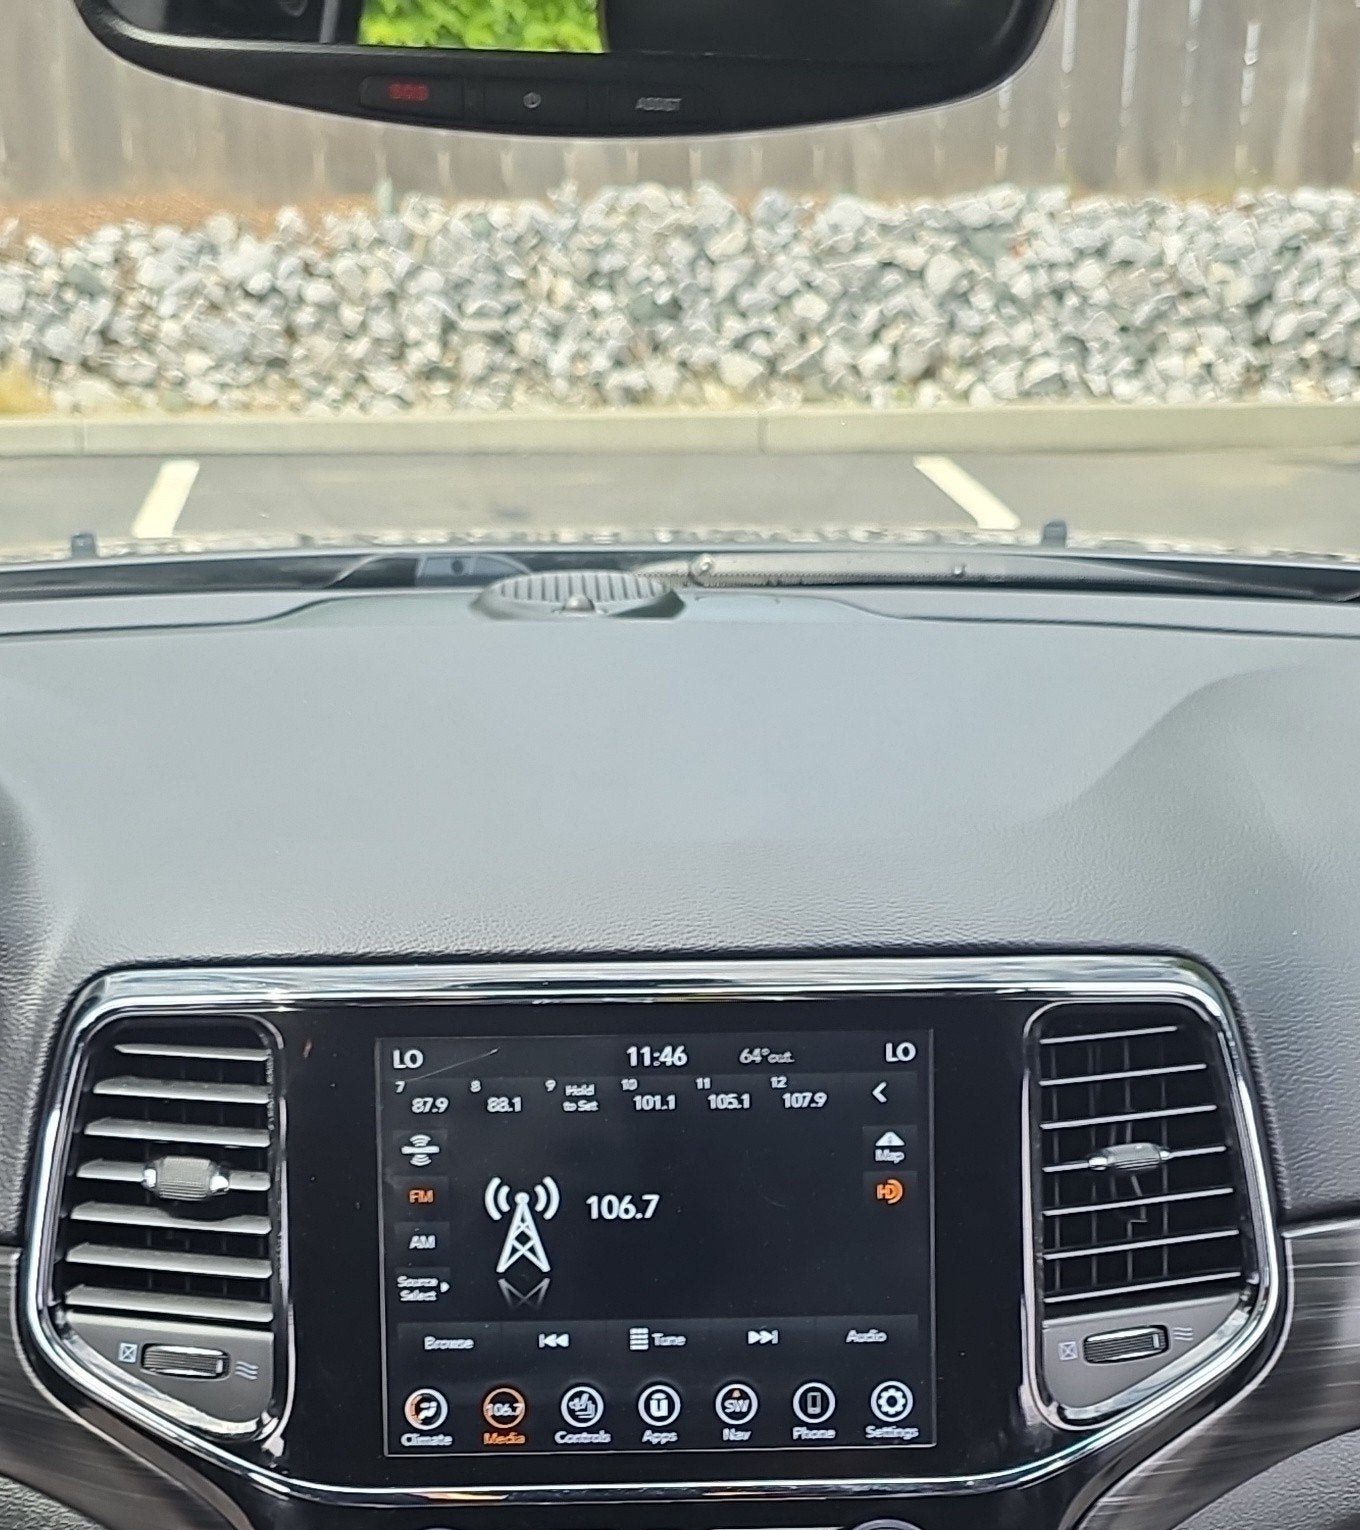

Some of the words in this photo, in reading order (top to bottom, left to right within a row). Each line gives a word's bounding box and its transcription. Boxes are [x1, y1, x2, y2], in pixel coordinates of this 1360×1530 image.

[393, 1049, 424, 1069] LO
[627, 1046, 688, 1067] 11:46
[885, 1042, 916, 1062] LO
[395, 1081, 405, 1093] 7
[470, 1080, 481, 1092] 8
[545, 1079, 556, 1091] 9
[621, 1079, 638, 1090] 10
[695, 1077, 711, 1089] 11
[770, 1076, 787, 1088] 12
[411, 1097, 449, 1113] 87.9
[487, 1096, 522, 1112] 88.1
[562, 1100, 577, 1112] to
[633, 1095, 676, 1111] 101.1
[707, 1093, 751, 1109] 105.1
[782, 1092, 827, 1108] 107.9
[875, 1149, 905, 1164] Map
[409, 1189, 434, 1204] FM
[586, 1194, 660, 1220] 106.7
[409, 1235, 436, 1249] AM
[397, 1275, 438, 1288] Source
[400, 1289, 437, 1301] Select
[424, 1336, 474, 1350] Browse
[652, 1332, 686, 1346] Tune
[845, 1330, 887, 1343] Audio
[486, 1403, 525, 1417] 106.7
[400, 1432, 453, 1447] Climate
[483, 1431, 526, 1445] Media
[554, 1430, 611, 1444] Controls
[642, 1429, 678, 1445] Apps
[722, 1427, 752, 1441] Nav
[792, 1426, 836, 1440] Phone
[865, 1425, 919, 1440] Settings
